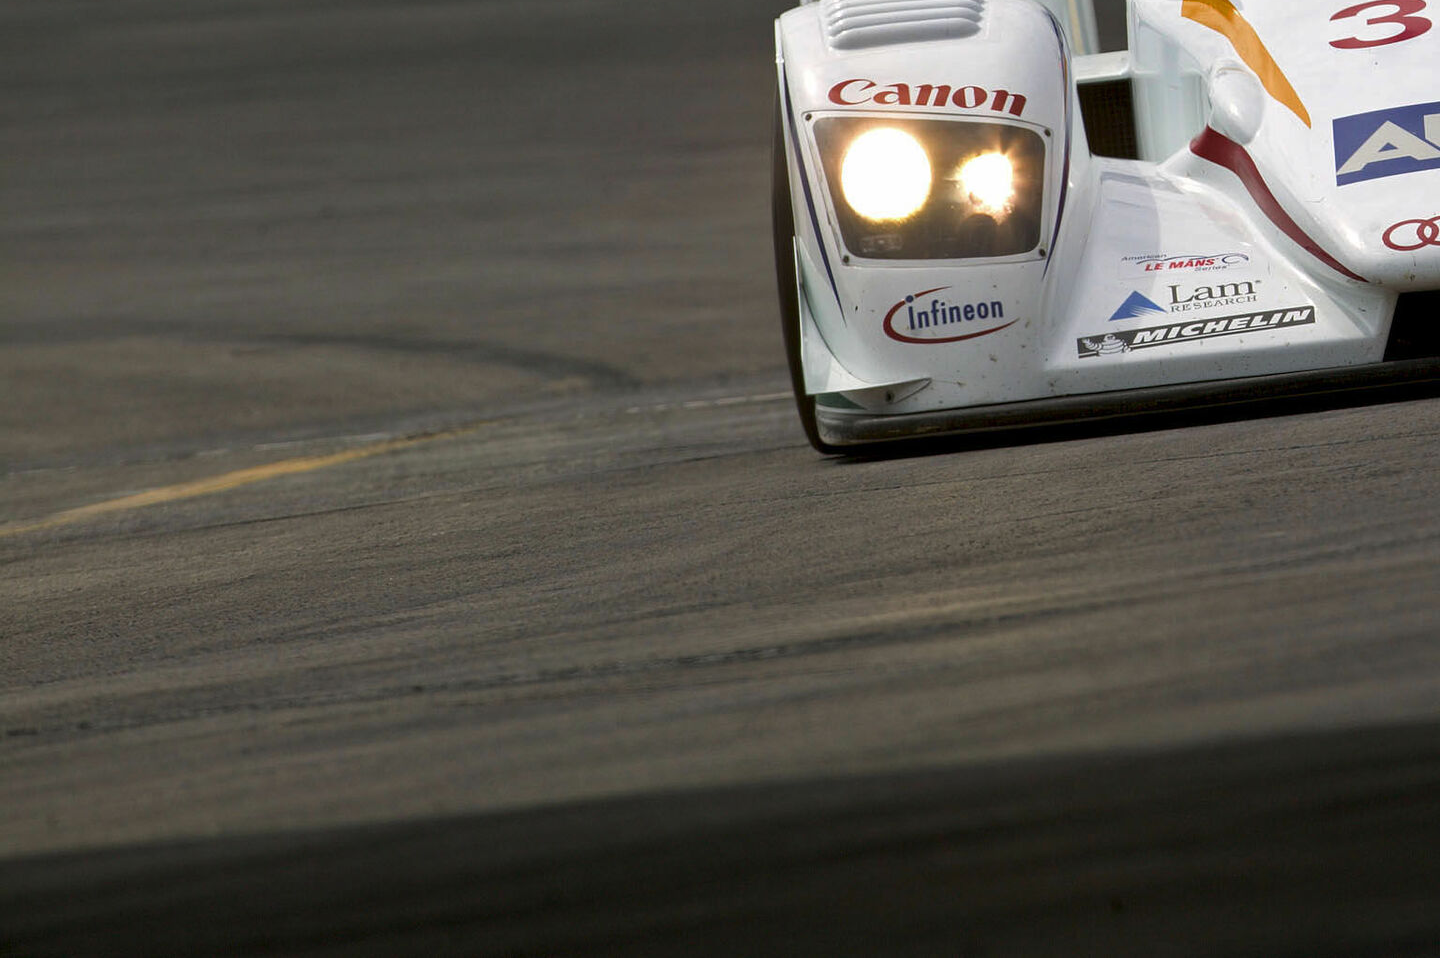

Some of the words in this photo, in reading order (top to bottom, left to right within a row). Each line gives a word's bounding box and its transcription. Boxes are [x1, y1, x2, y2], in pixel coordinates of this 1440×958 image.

[828, 79, 1027, 117] Canon
[1145, 263, 1163, 272] LE
[1169, 258, 1216, 269] MANS
[1168, 281, 1258, 305] Lam
[1170, 295, 1257, 313] RESEARCH
[1132, 309, 1311, 344] MICHELIN
